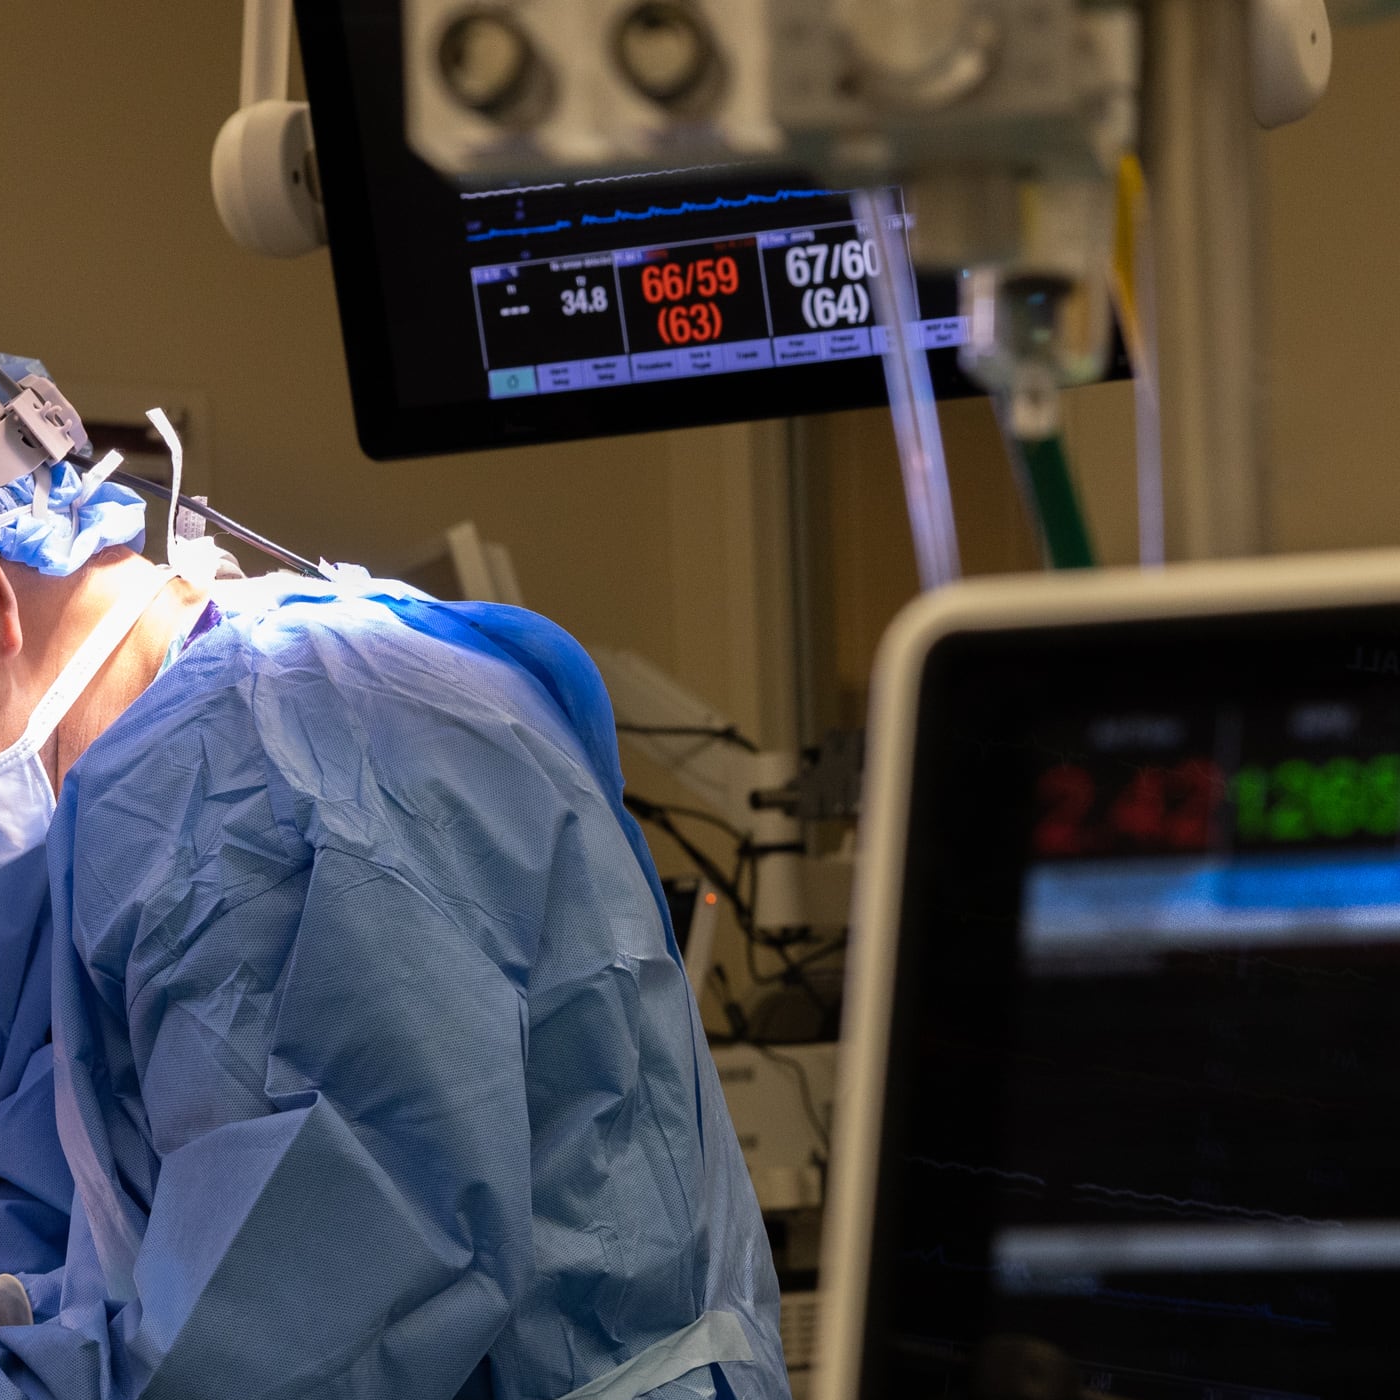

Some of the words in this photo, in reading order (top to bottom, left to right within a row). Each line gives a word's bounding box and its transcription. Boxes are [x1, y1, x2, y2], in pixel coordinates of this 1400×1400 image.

[641, 256, 739, 304] 66/59
[785, 239, 881, 287] 67/60
[560, 286, 608, 316] 34.8
[657, 302, 723, 344] (63)
[802, 284, 870, 328] (64)
